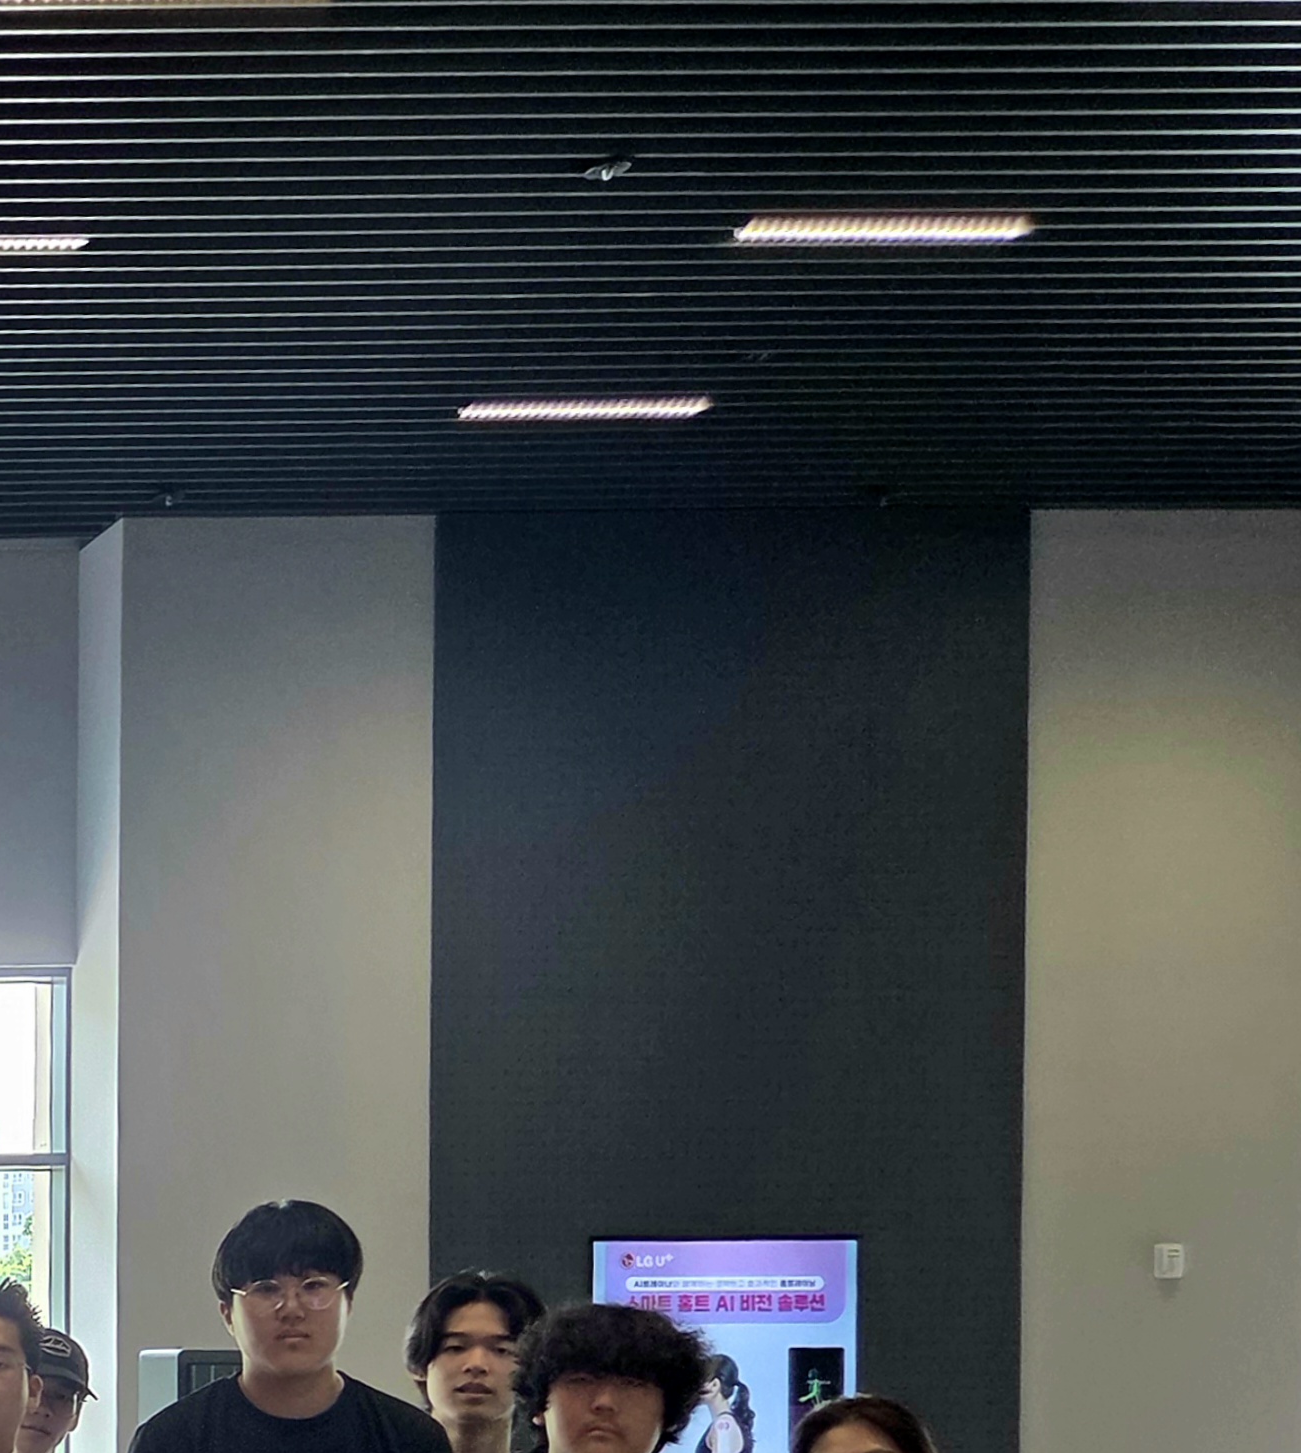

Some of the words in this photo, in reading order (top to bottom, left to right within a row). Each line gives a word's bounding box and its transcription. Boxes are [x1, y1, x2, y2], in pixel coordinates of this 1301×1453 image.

[636, 1254, 654, 1268] LG
[655, 1253, 674, 1268] U+
[678, 1294, 710, 1312] 홈트
[715, 1295, 735, 1312] AI
[740, 1294, 772, 1312] 비전
[778, 1294, 826, 1312] 솔루션
